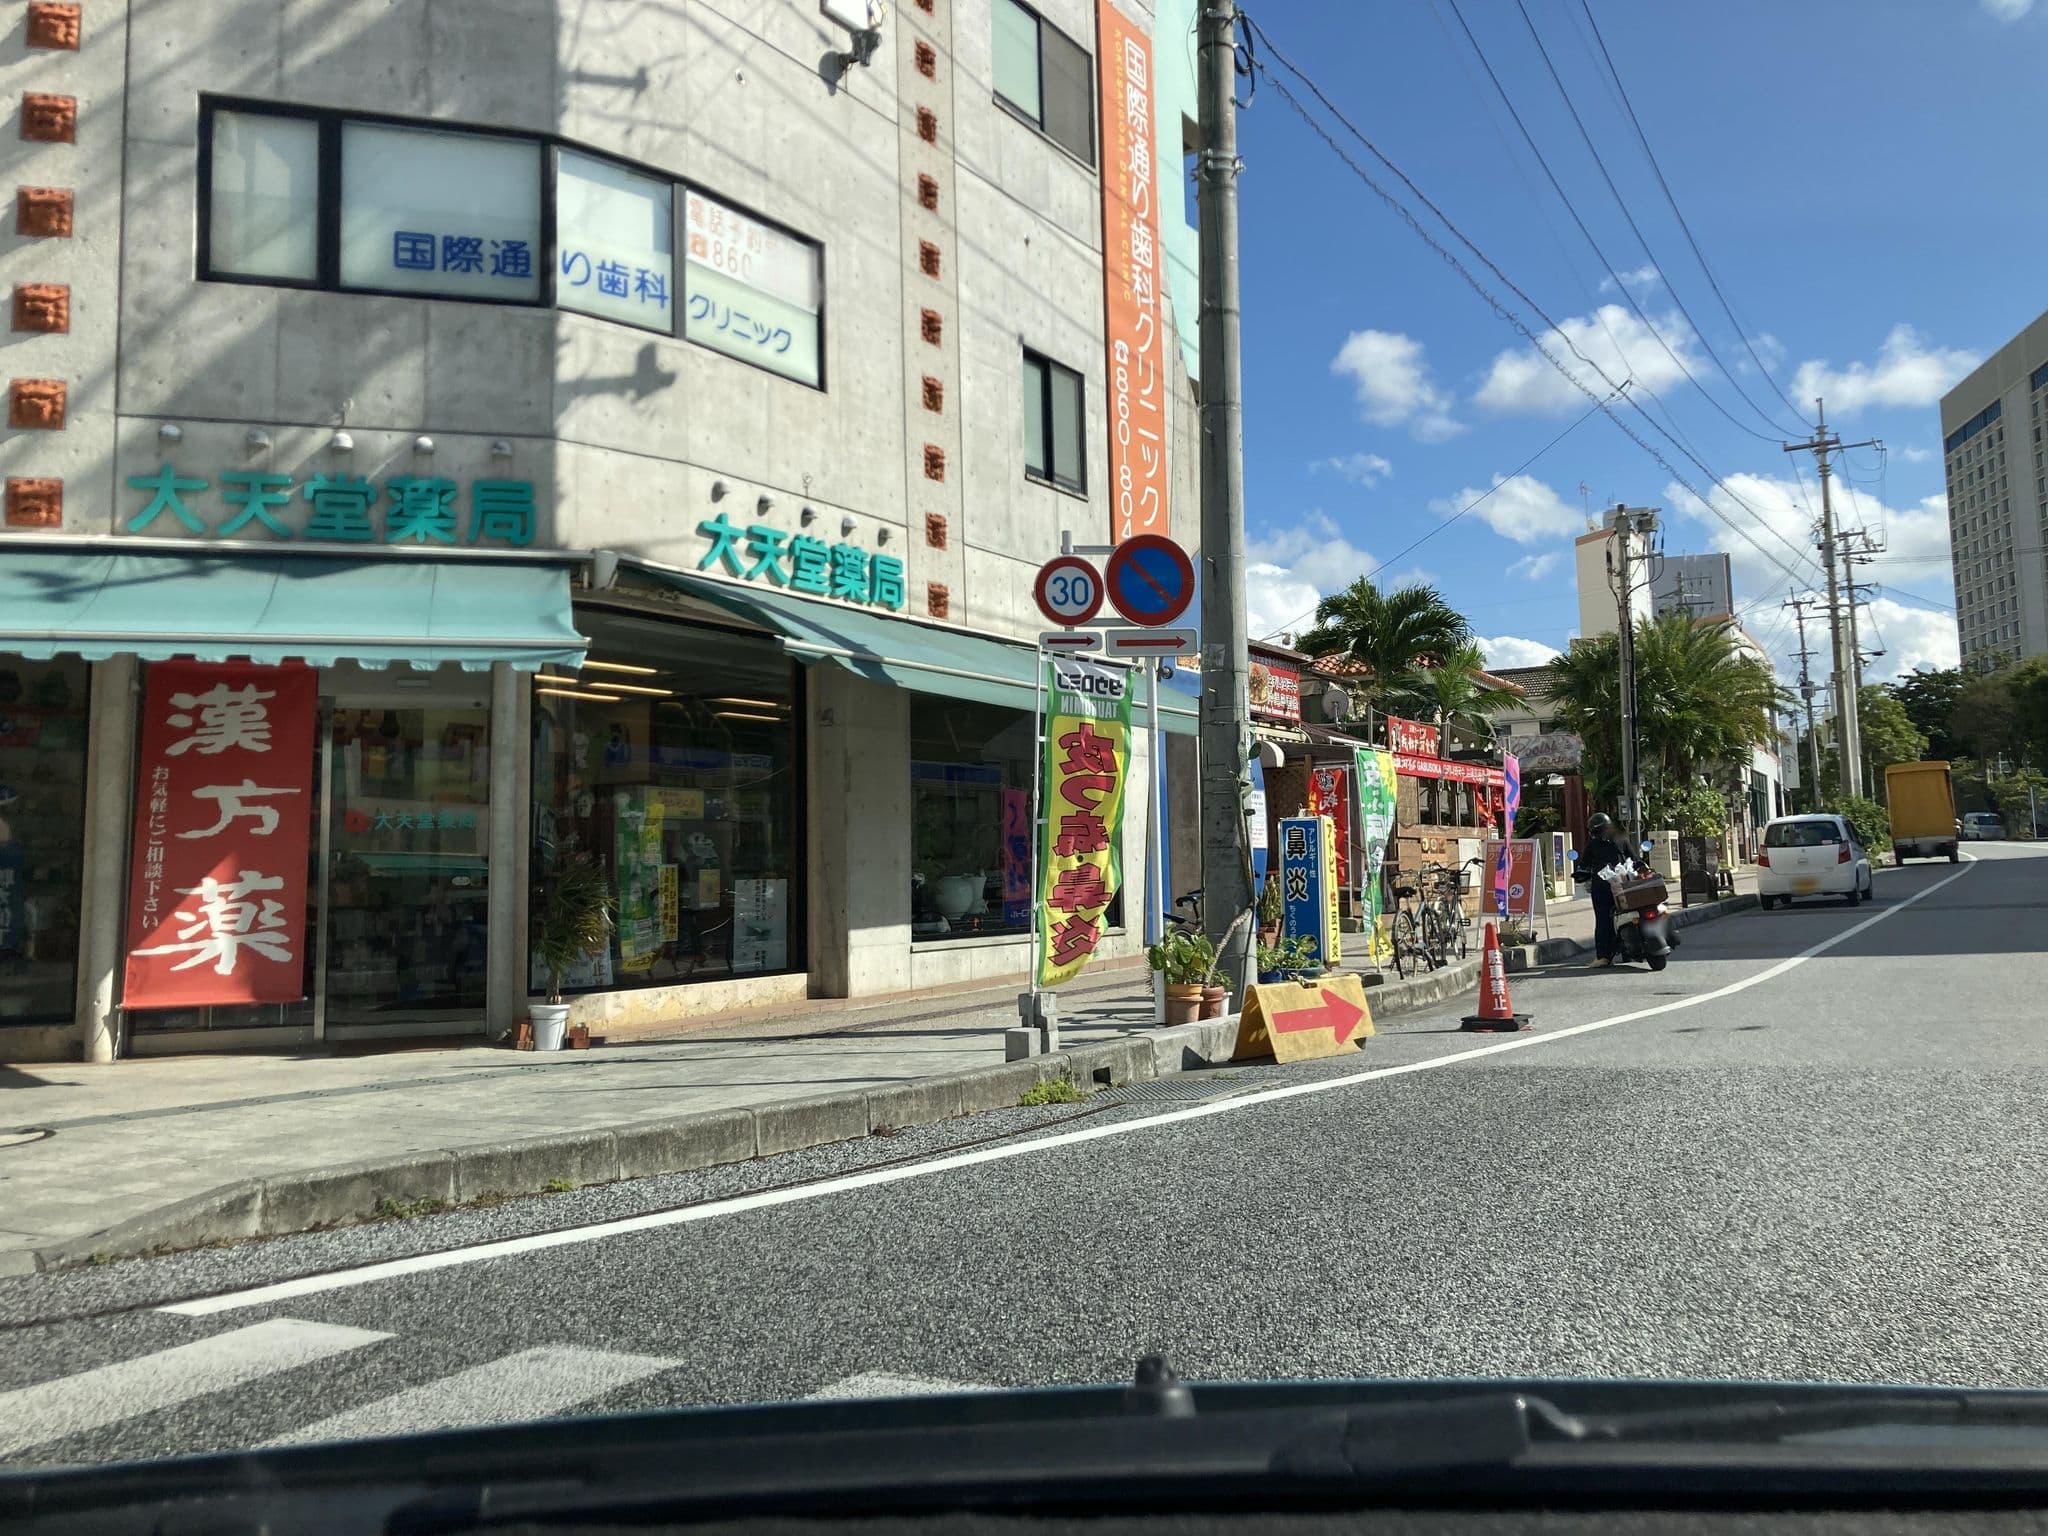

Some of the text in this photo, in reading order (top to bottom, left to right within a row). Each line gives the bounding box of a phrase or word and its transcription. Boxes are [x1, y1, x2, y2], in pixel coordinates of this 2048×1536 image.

[1124, 36, 1159, 528] 国際通り歯科クリニック
[127, 463, 537, 547] 大天堂薬局
[697, 513, 905, 612] 大天堂薬局
[1052, 576, 1089, 606] 30
[130, 683, 301, 976] 漢方薬
[142, 765, 170, 928] お気軽にご相談下さい
[1285, 826, 1309, 902] 鼻炎
[1511, 886, 1523, 897] 2F
